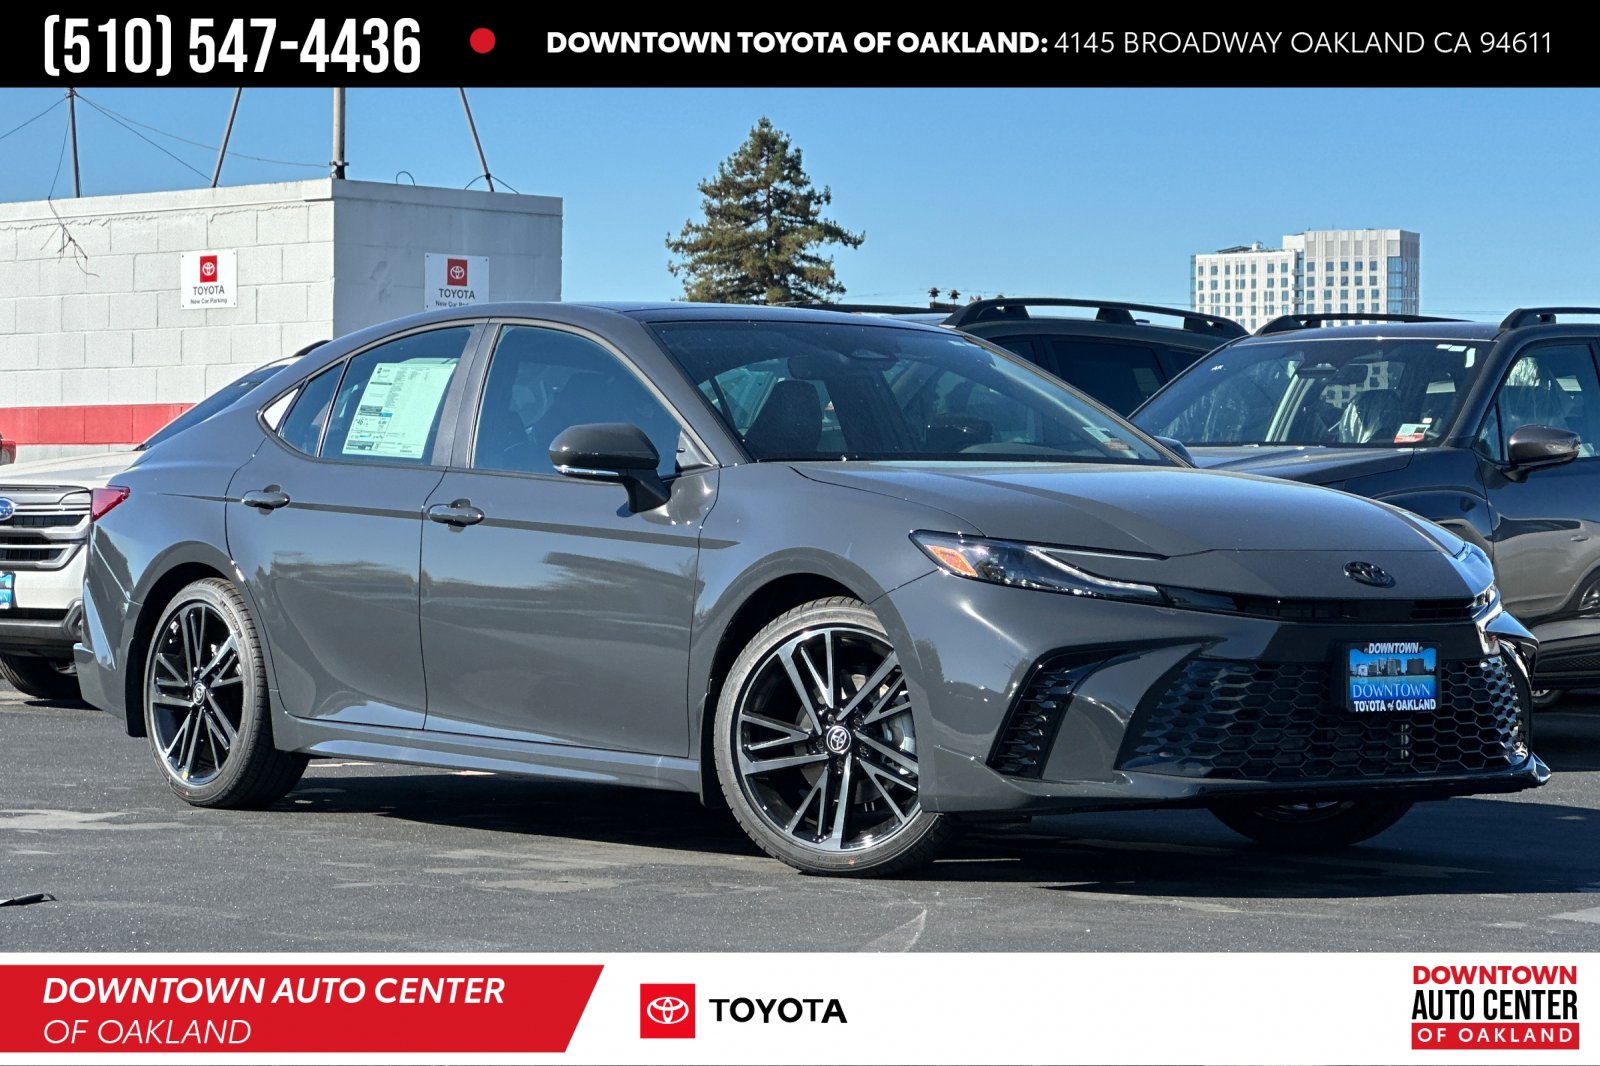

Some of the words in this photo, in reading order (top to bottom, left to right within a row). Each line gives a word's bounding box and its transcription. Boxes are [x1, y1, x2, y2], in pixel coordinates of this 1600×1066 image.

[193, 285, 225, 295] TOYOTA
[438, 288, 475, 299] TOYOTA
[1368, 642, 1419, 654] DOWNTOWN
[1353, 683, 1430, 698] DOWNTOWN
[1353, 700, 1386, 712] TOYOTA
[1396, 699, 1437, 711] OAKLAND
